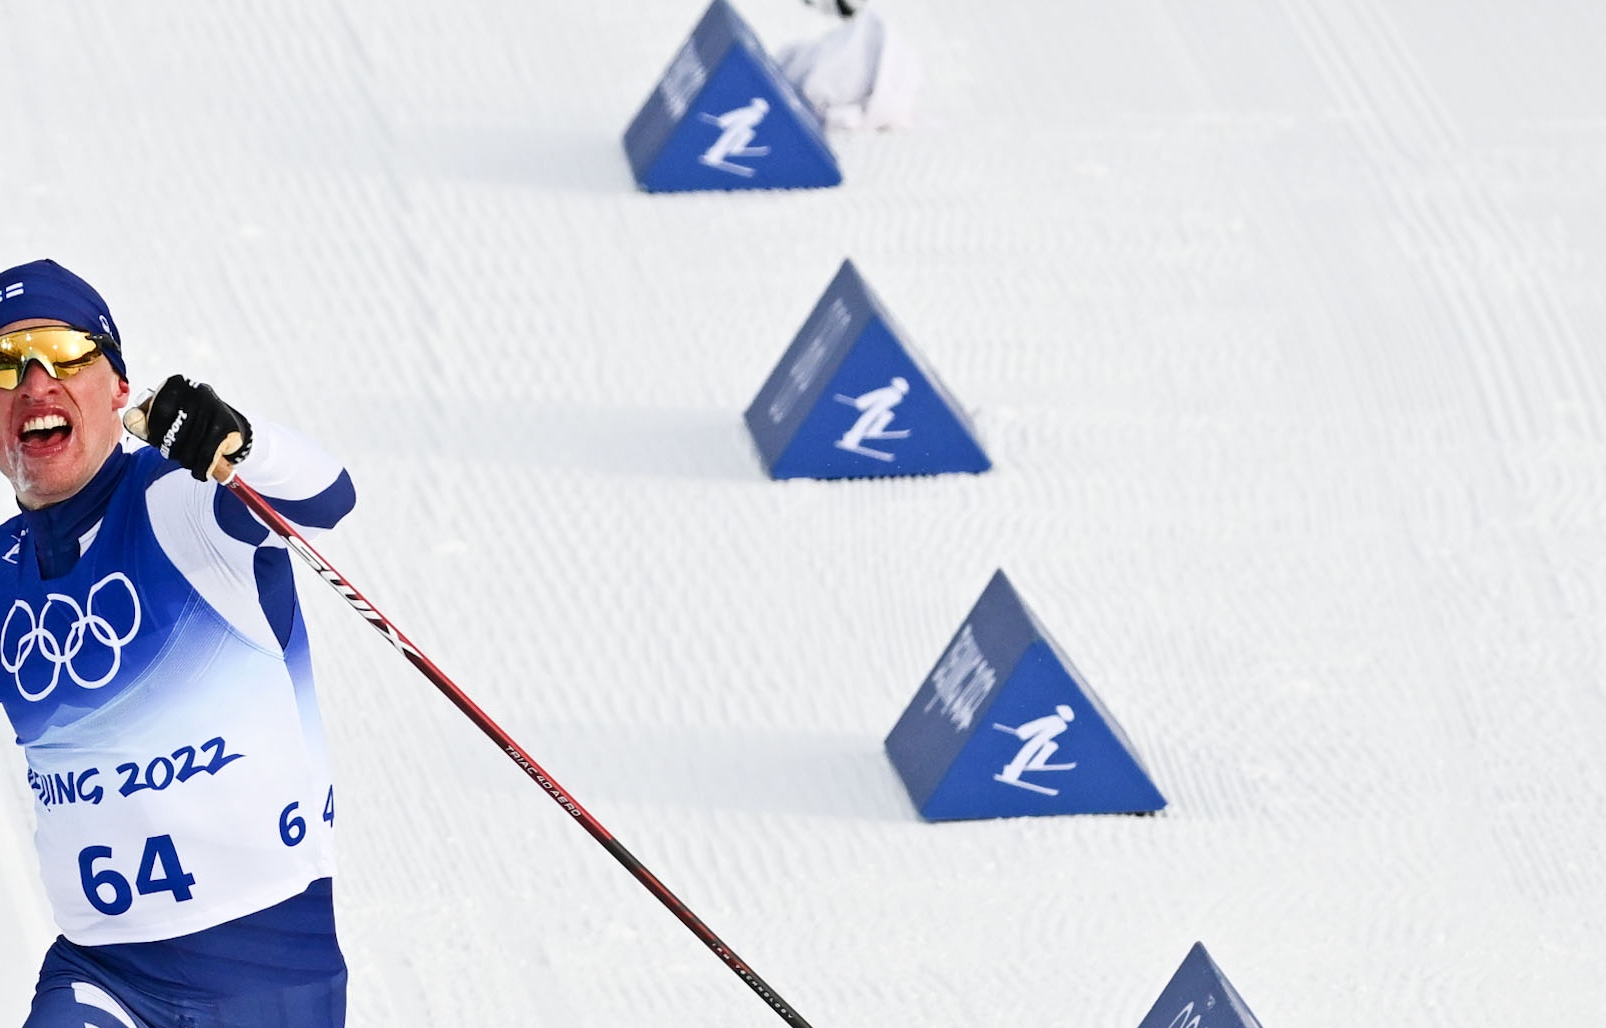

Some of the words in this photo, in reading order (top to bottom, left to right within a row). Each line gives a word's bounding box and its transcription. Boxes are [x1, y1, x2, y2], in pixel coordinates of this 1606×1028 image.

[283, 533, 424, 664] SWIX
[115, 736, 247, 798] 2022
[505, 744, 538, 774] TRIAC
[550, 789, 582, 817] AERO
[78, 834, 196, 916] 64
